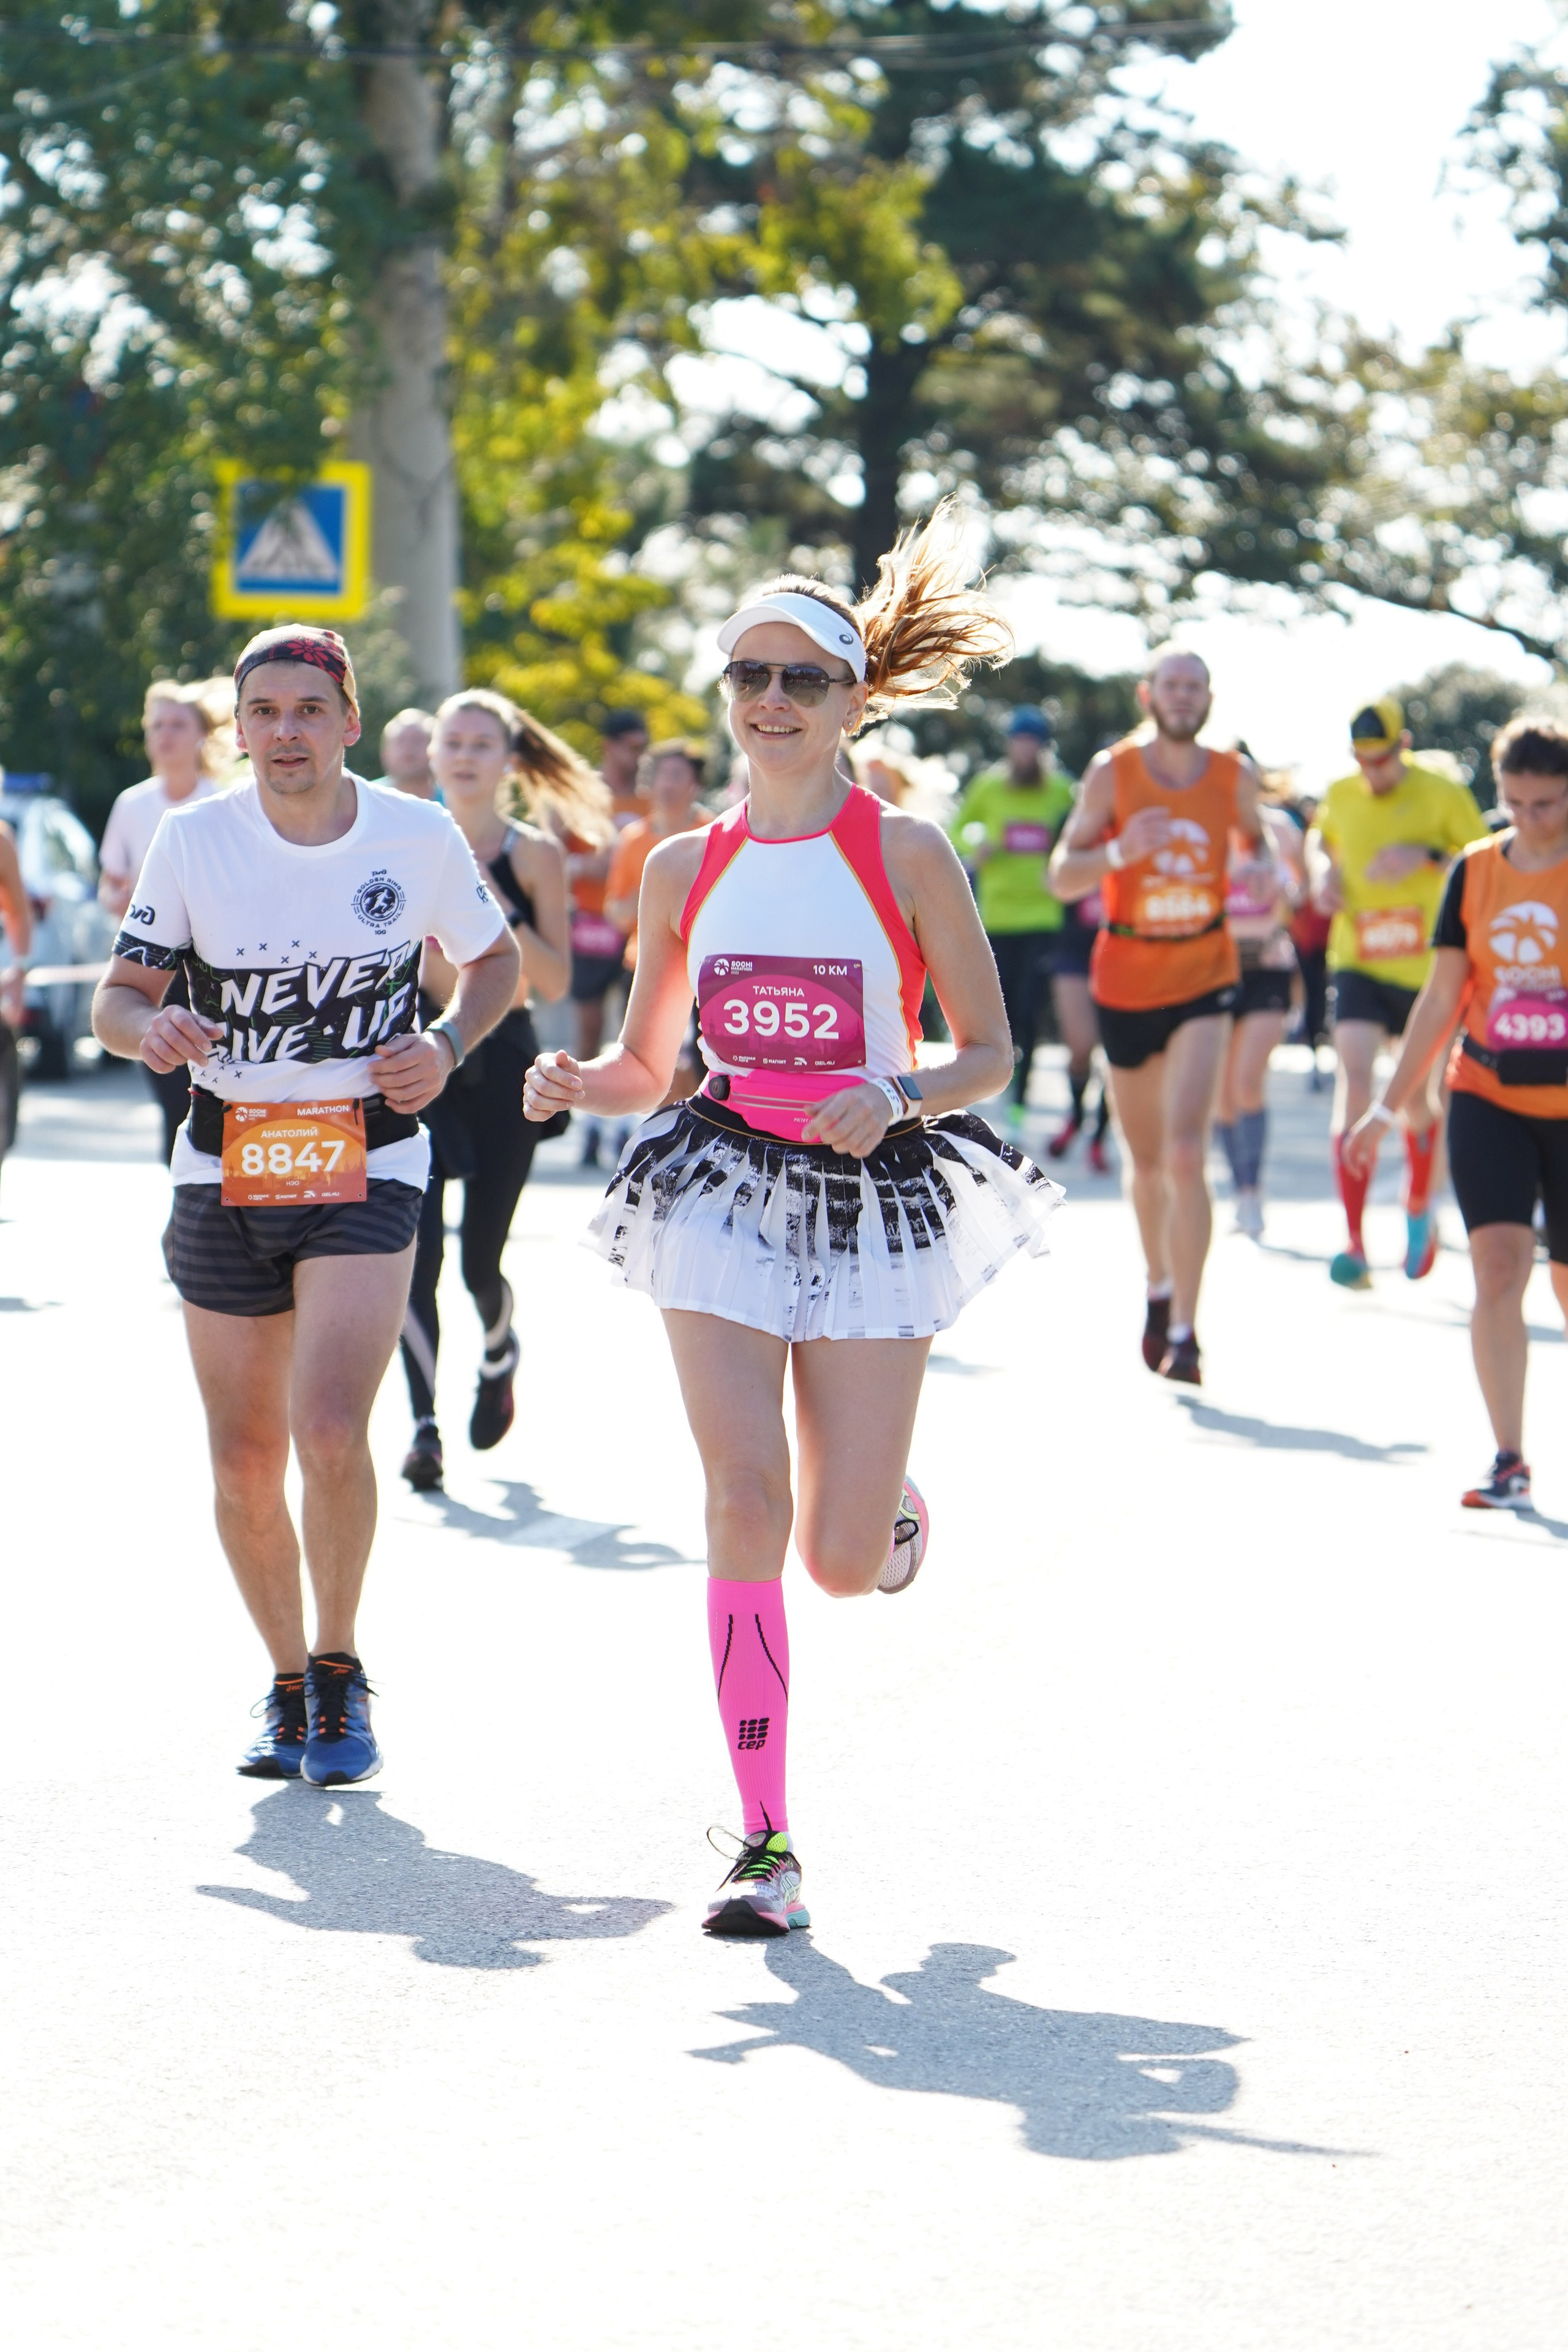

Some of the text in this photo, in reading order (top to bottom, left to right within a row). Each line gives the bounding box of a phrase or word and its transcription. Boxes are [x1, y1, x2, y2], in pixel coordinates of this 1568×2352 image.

[357, 877, 402, 894] GOLDEN RING
[358, 912, 402, 928] ULTRA TRAIL
[813, 965, 848, 976] 10 KM
[220, 941, 410, 1017] NEVER
[752, 985, 805, 997] ТАТЬЯНА
[723, 999, 839, 1039] 3952
[1494, 1013, 1566, 1041] 4393
[297, 1105, 350, 1116] MARATHON
[260, 1126, 318, 1139] АНАТОЛИЙ
[241, 1140, 345, 1175] 8847
[737, 1740, 766, 1750] cep
